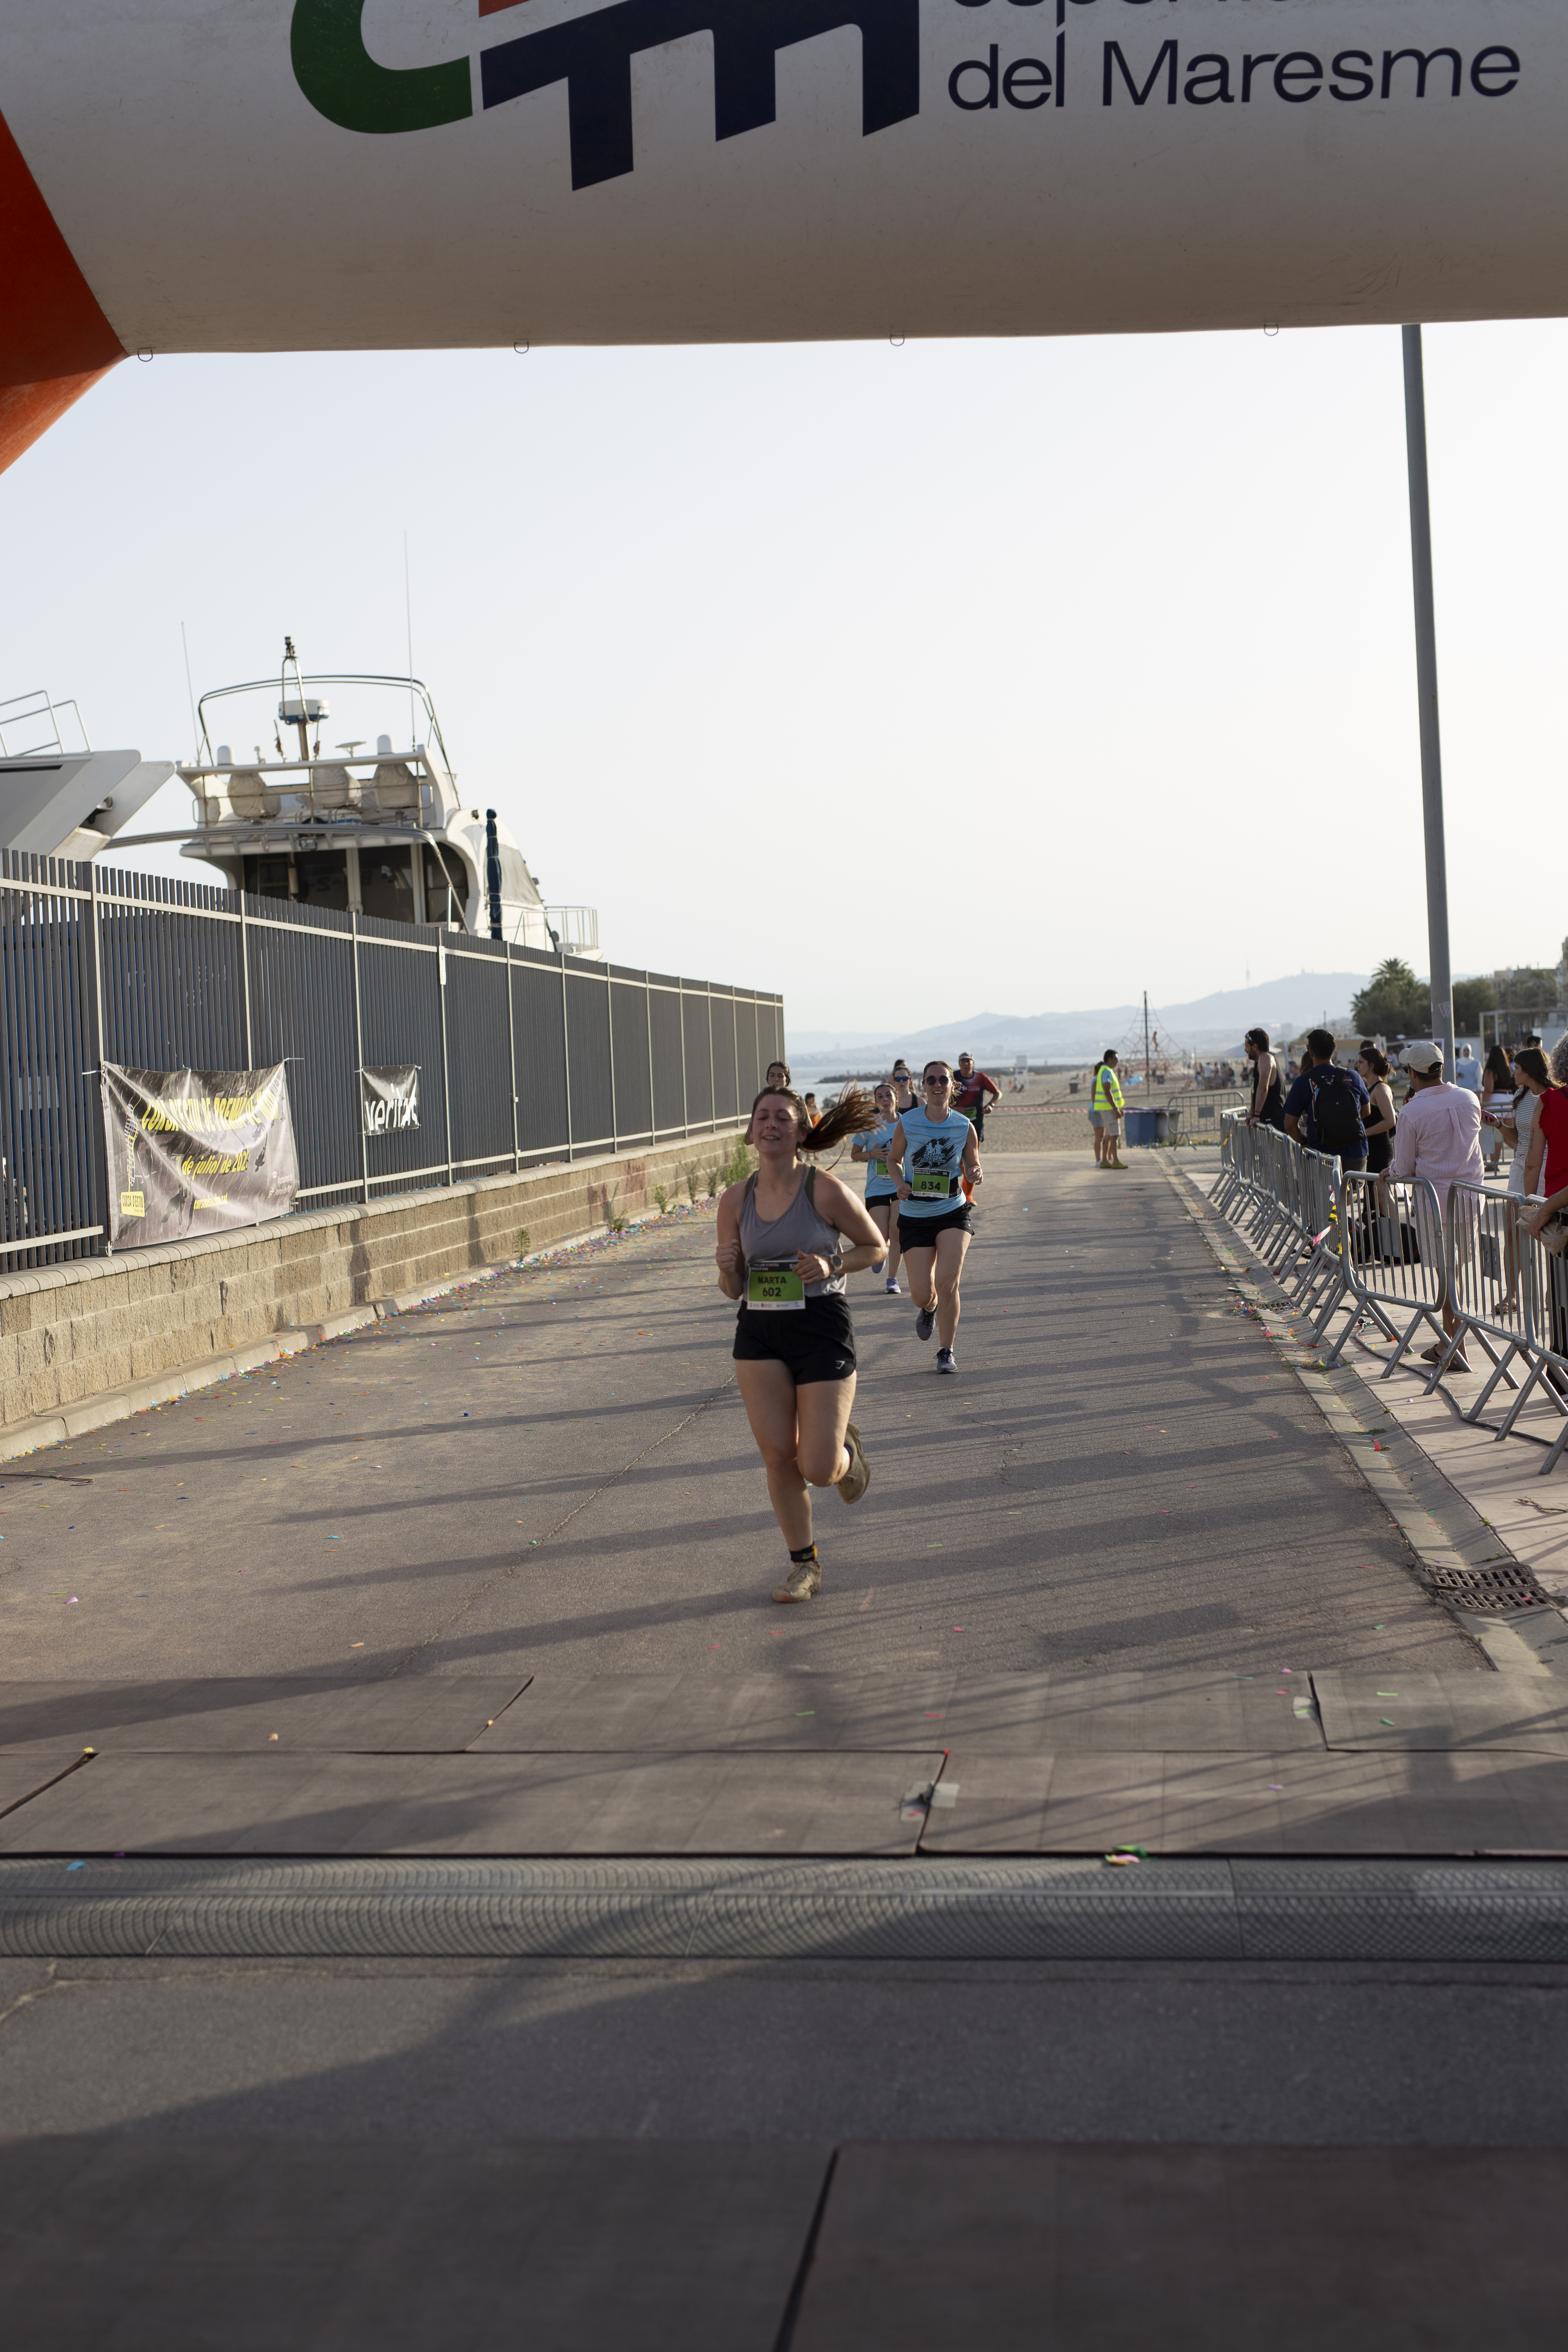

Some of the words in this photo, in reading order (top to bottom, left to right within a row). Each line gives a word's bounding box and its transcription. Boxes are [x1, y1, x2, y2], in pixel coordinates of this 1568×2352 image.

[948, 30, 1065, 110] del
[1102, 39, 1520, 106] Maresme
[201, 1097, 216, 1133] DE
[365, 1083, 417, 1131] veritas
[182, 1155, 194, 1176] de
[192, 1154, 223, 1181] juliol
[220, 1154, 232, 1174] de
[231, 1151, 249, 1173] 2026
[122, 1195, 132, 1207] CURSA
[921, 1181, 941, 1191] 834
[763, 1287, 781, 1297] 602
